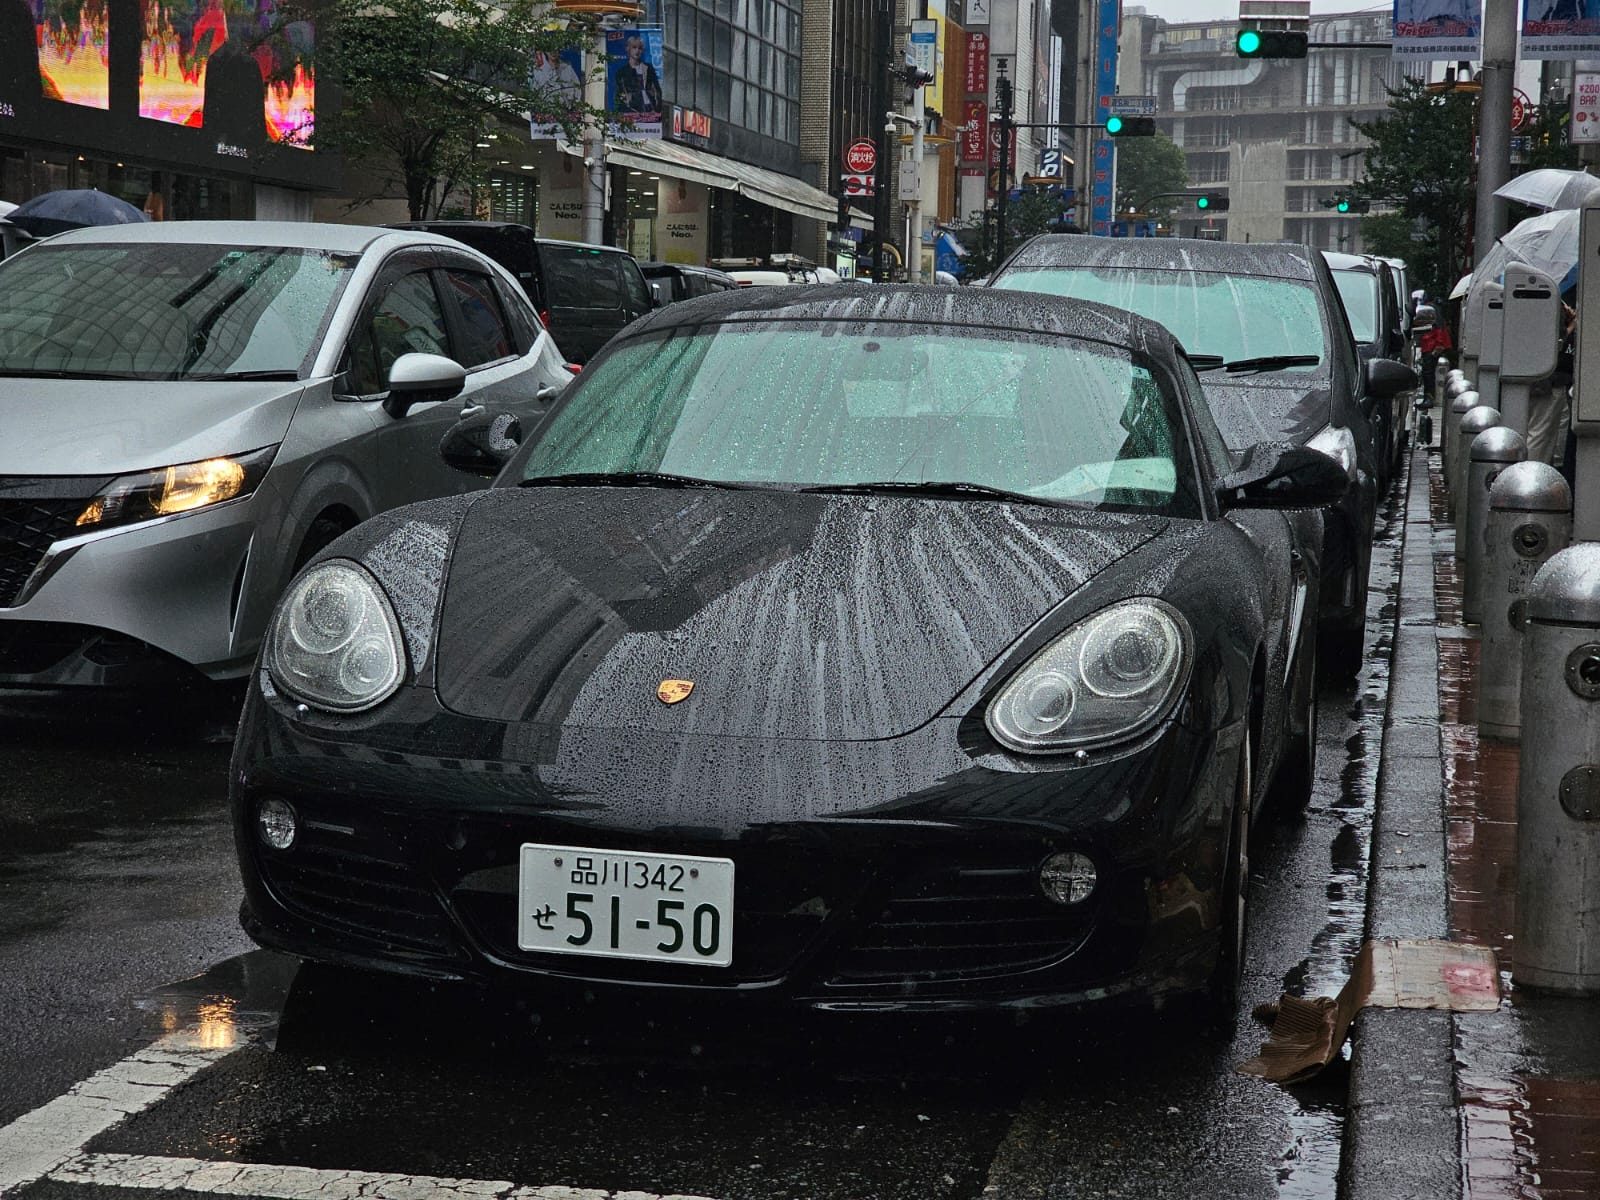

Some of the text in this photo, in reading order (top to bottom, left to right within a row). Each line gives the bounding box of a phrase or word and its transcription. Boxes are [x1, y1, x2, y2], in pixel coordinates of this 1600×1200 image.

[1579, 95, 1598, 106] BAR
[685, 109, 709, 137] LABI
[850, 151, 874, 164] 消火栓
[532, 892, 720, 956] せ 51-50
